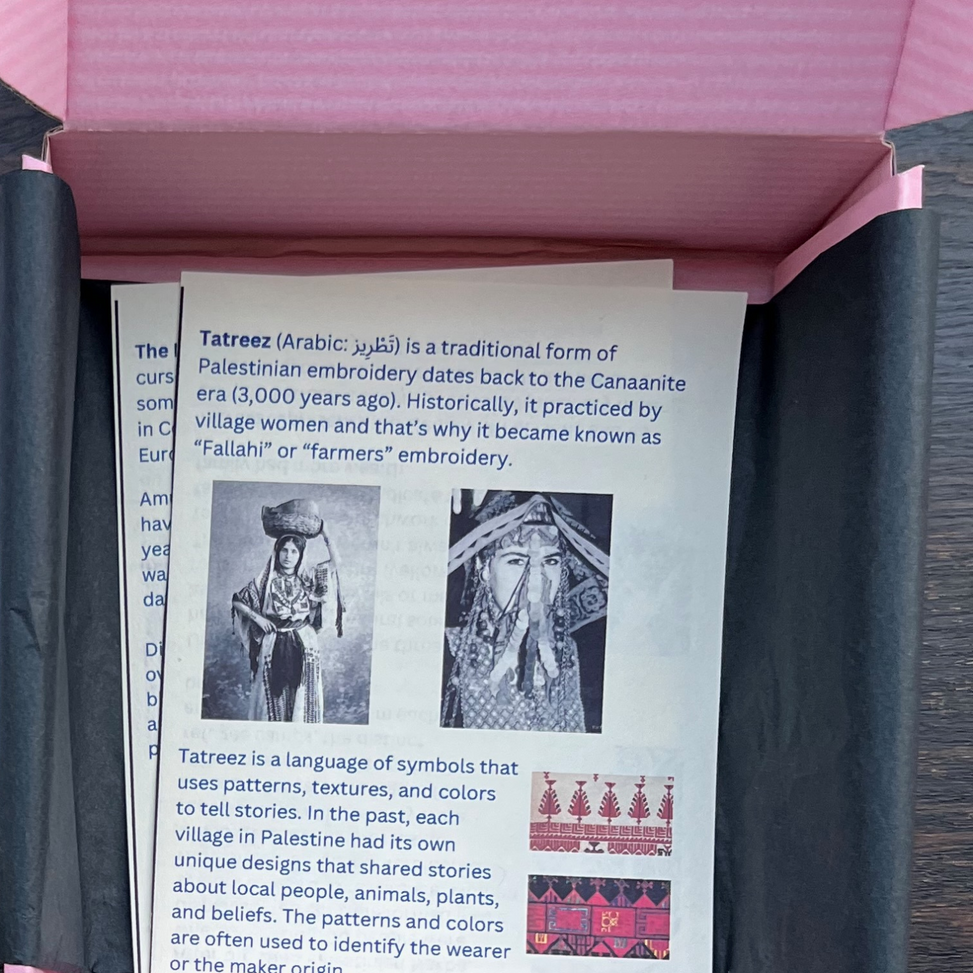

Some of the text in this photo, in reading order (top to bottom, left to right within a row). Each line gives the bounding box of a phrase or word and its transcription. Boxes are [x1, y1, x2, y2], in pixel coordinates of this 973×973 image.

[135, 343, 168, 359] The
[199, 330, 271, 349] Tatreez
[277, 332, 348, 352] (Arabic:
[406, 337, 420, 354] is
[425, 342, 436, 355] a
[441, 340, 541, 359] traditional
[546, 342, 591, 361] form
[597, 344, 618, 362] of
[199, 357, 686, 392] Palestinian embroidery dates back to the Canaanite
[197, 385, 663, 422] era (3,000 years ago). Historically, it practiced by
[138, 421, 174, 437] in C
[195, 412, 661, 445] village women and that’s why it became known as
[194, 439, 272, 458] “Fallahi”
[277, 446, 298, 459] or
[303, 442, 393, 462] “farmers”
[398, 447, 512, 471] embroidery.
[140, 492, 171, 506] Am
[178, 748, 519, 776] Tatreez is a language of symbols that
[178, 778, 496, 801] uses patterns, textures, and colors
[176, 801, 459, 827] to tell stories. In the past, each
[175, 826, 455, 852] village in Palestine had its own
[174, 852, 491, 880] unique designs that shared stories
[173, 877, 499, 909] about local people, animals, plants,
[172, 904, 504, 933] and beliefs. The patterns and colors
[170, 930, 512, 959] are often used to identify the wearer
[170, 959, 190, 971] or
[193, 956, 224, 973] the
